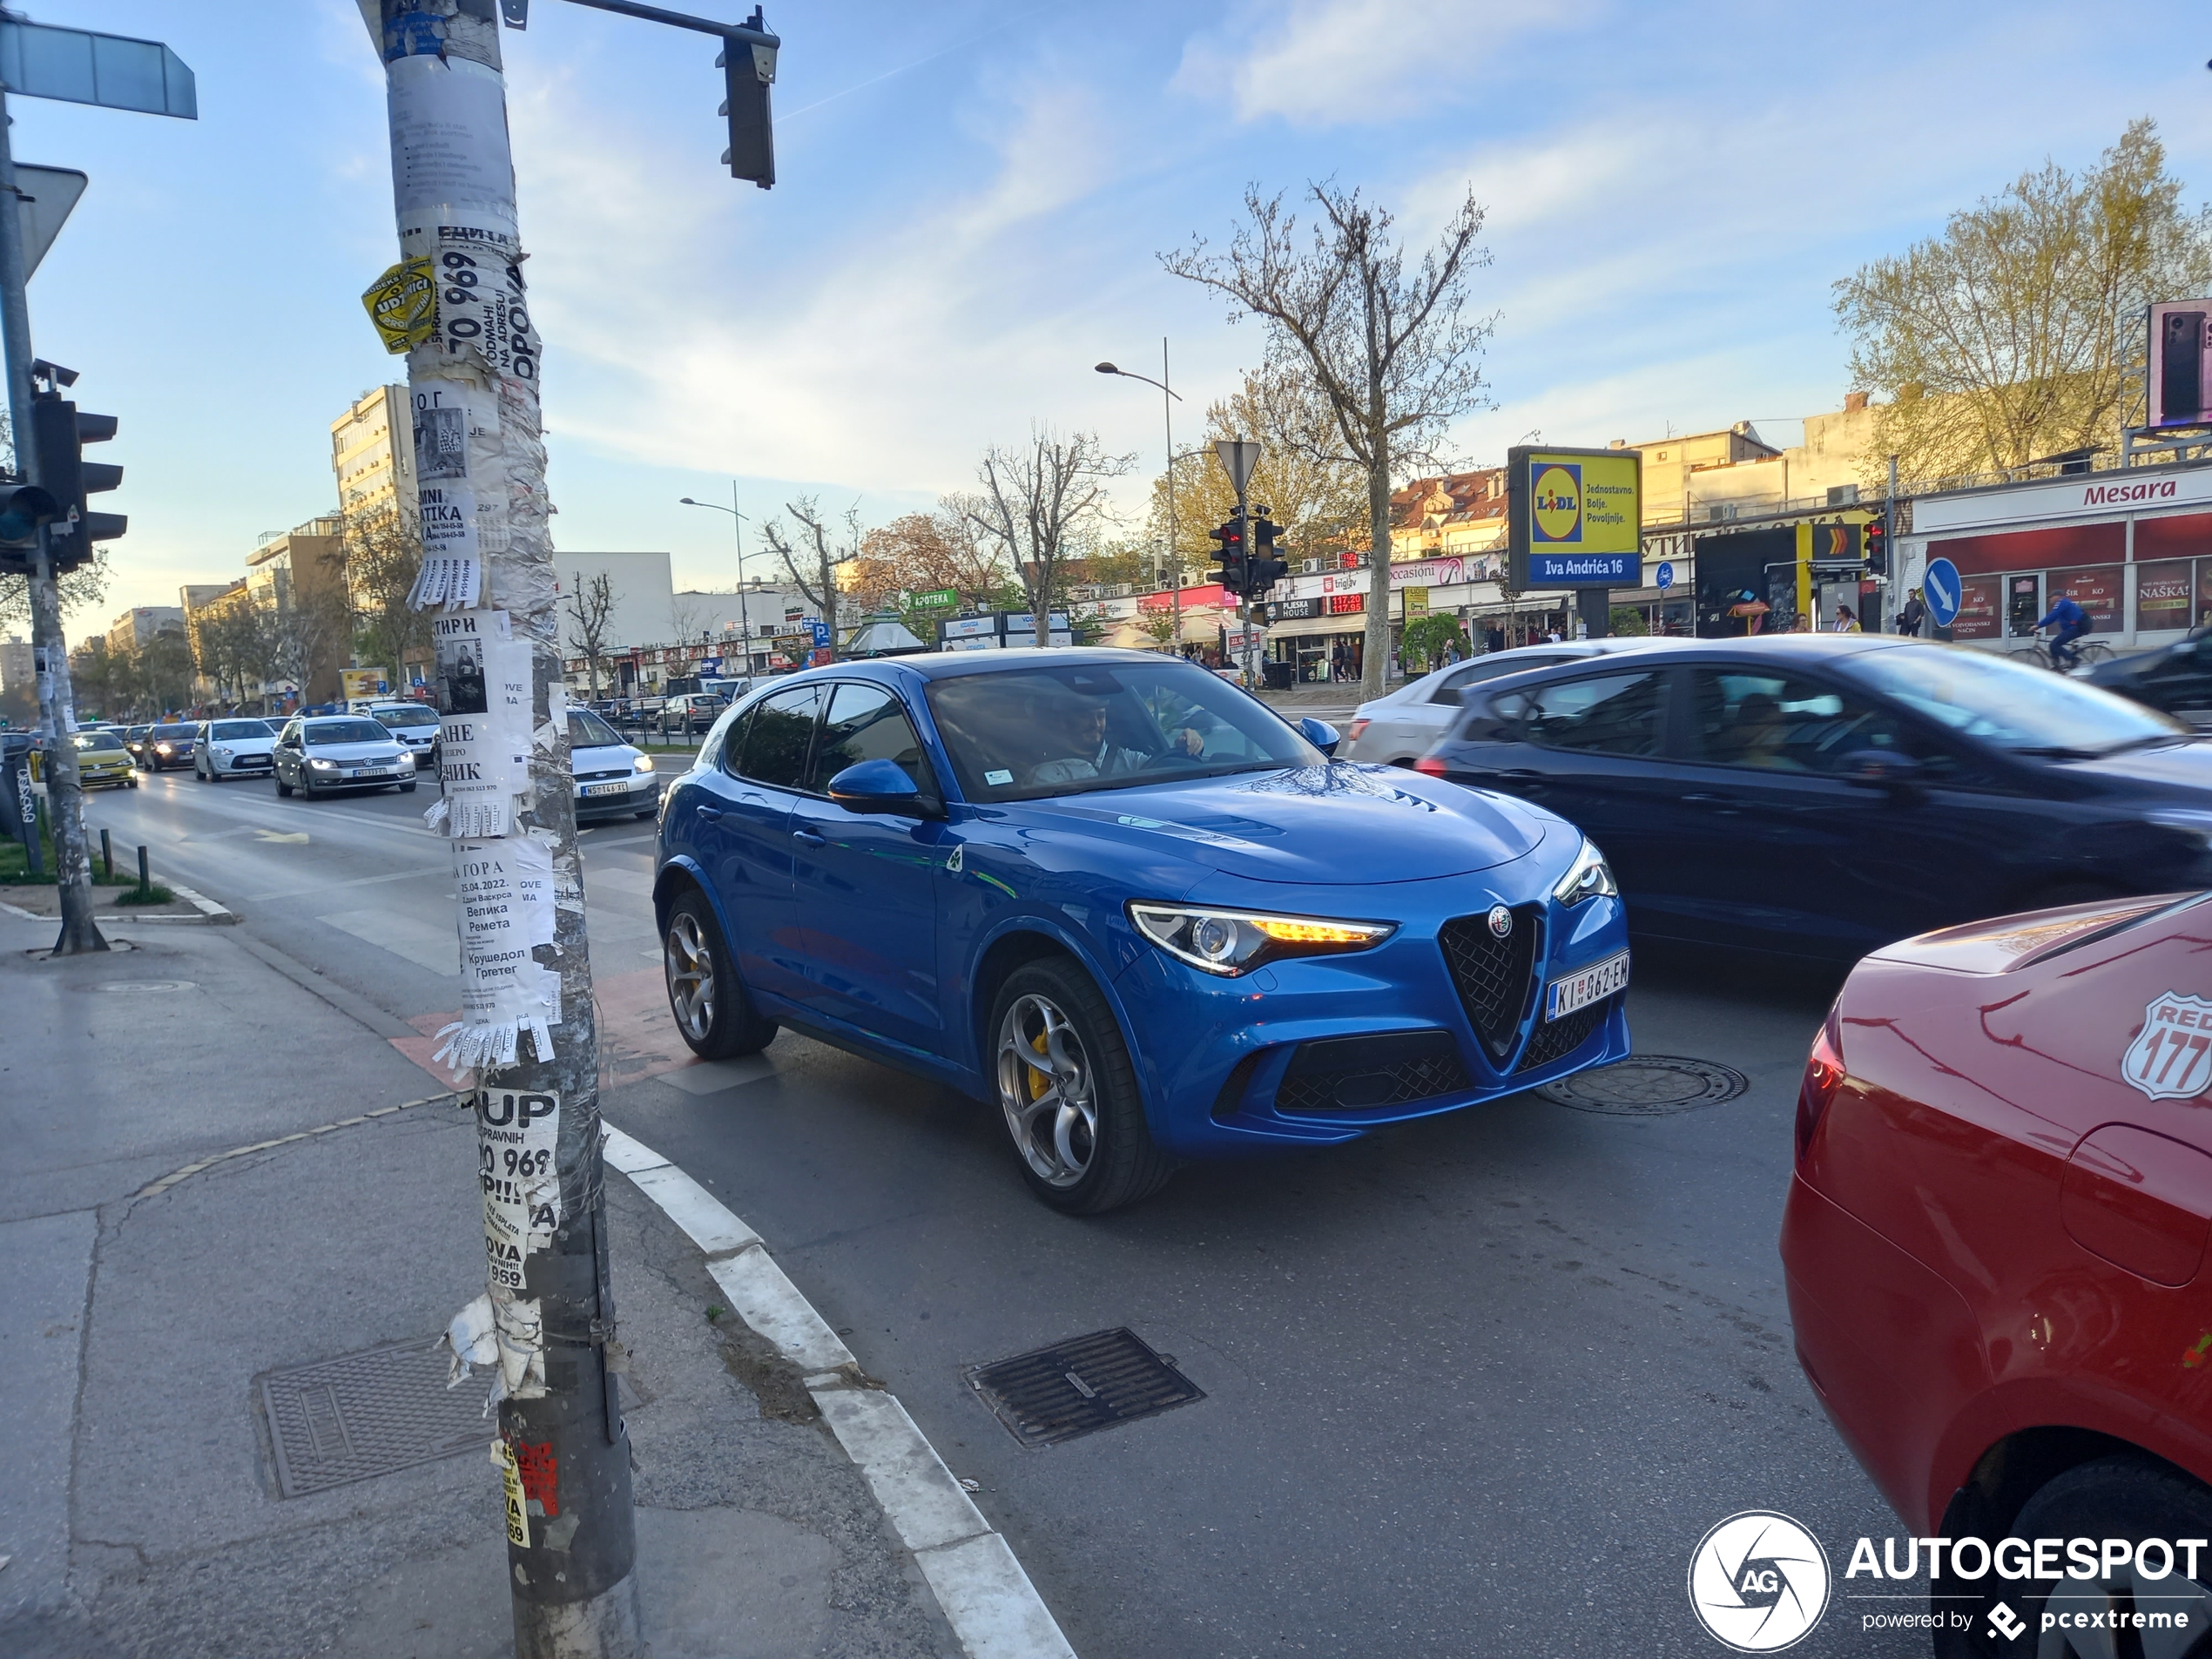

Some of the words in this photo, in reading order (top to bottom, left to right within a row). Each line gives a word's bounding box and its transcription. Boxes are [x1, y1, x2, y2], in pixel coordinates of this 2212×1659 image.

[442, 252, 479, 305] 969
[1586, 483, 1635, 495] Jednostavno.
[2083, 480, 2176, 506] Mesara
[1586, 498, 1608, 511] Bolje.
[1586, 513, 1626, 525] Povoljnije.
[1545, 560, 1564, 576] Iva
[1566, 558, 1609, 575] Andrića
[1610, 559, 1623, 574] 16
[1335, 578, 1357, 590] triglav
[2140, 585, 2189, 599] NAŠKA!
[915, 593, 948, 607] APOTEKA
[1283, 600, 1309, 610] PLJESKA
[1332, 595, 1361, 604] 117.20
[1283, 608, 1309, 617] HOUSE
[1332, 604, 1361, 613] 117.95
[463, 860, 504, 878] ГОРА
[477, 892, 513, 902] Васкрса
[467, 904, 509, 918] Велика
[469, 920, 510, 933] Ремета
[468, 949, 526, 966] Крушедол
[2139, 1027, 2212, 1089] 177
[503, 1149, 550, 1177] 969
[495, 1212, 520, 1236] ISPLATA
[492, 1265, 522, 1287] 969
